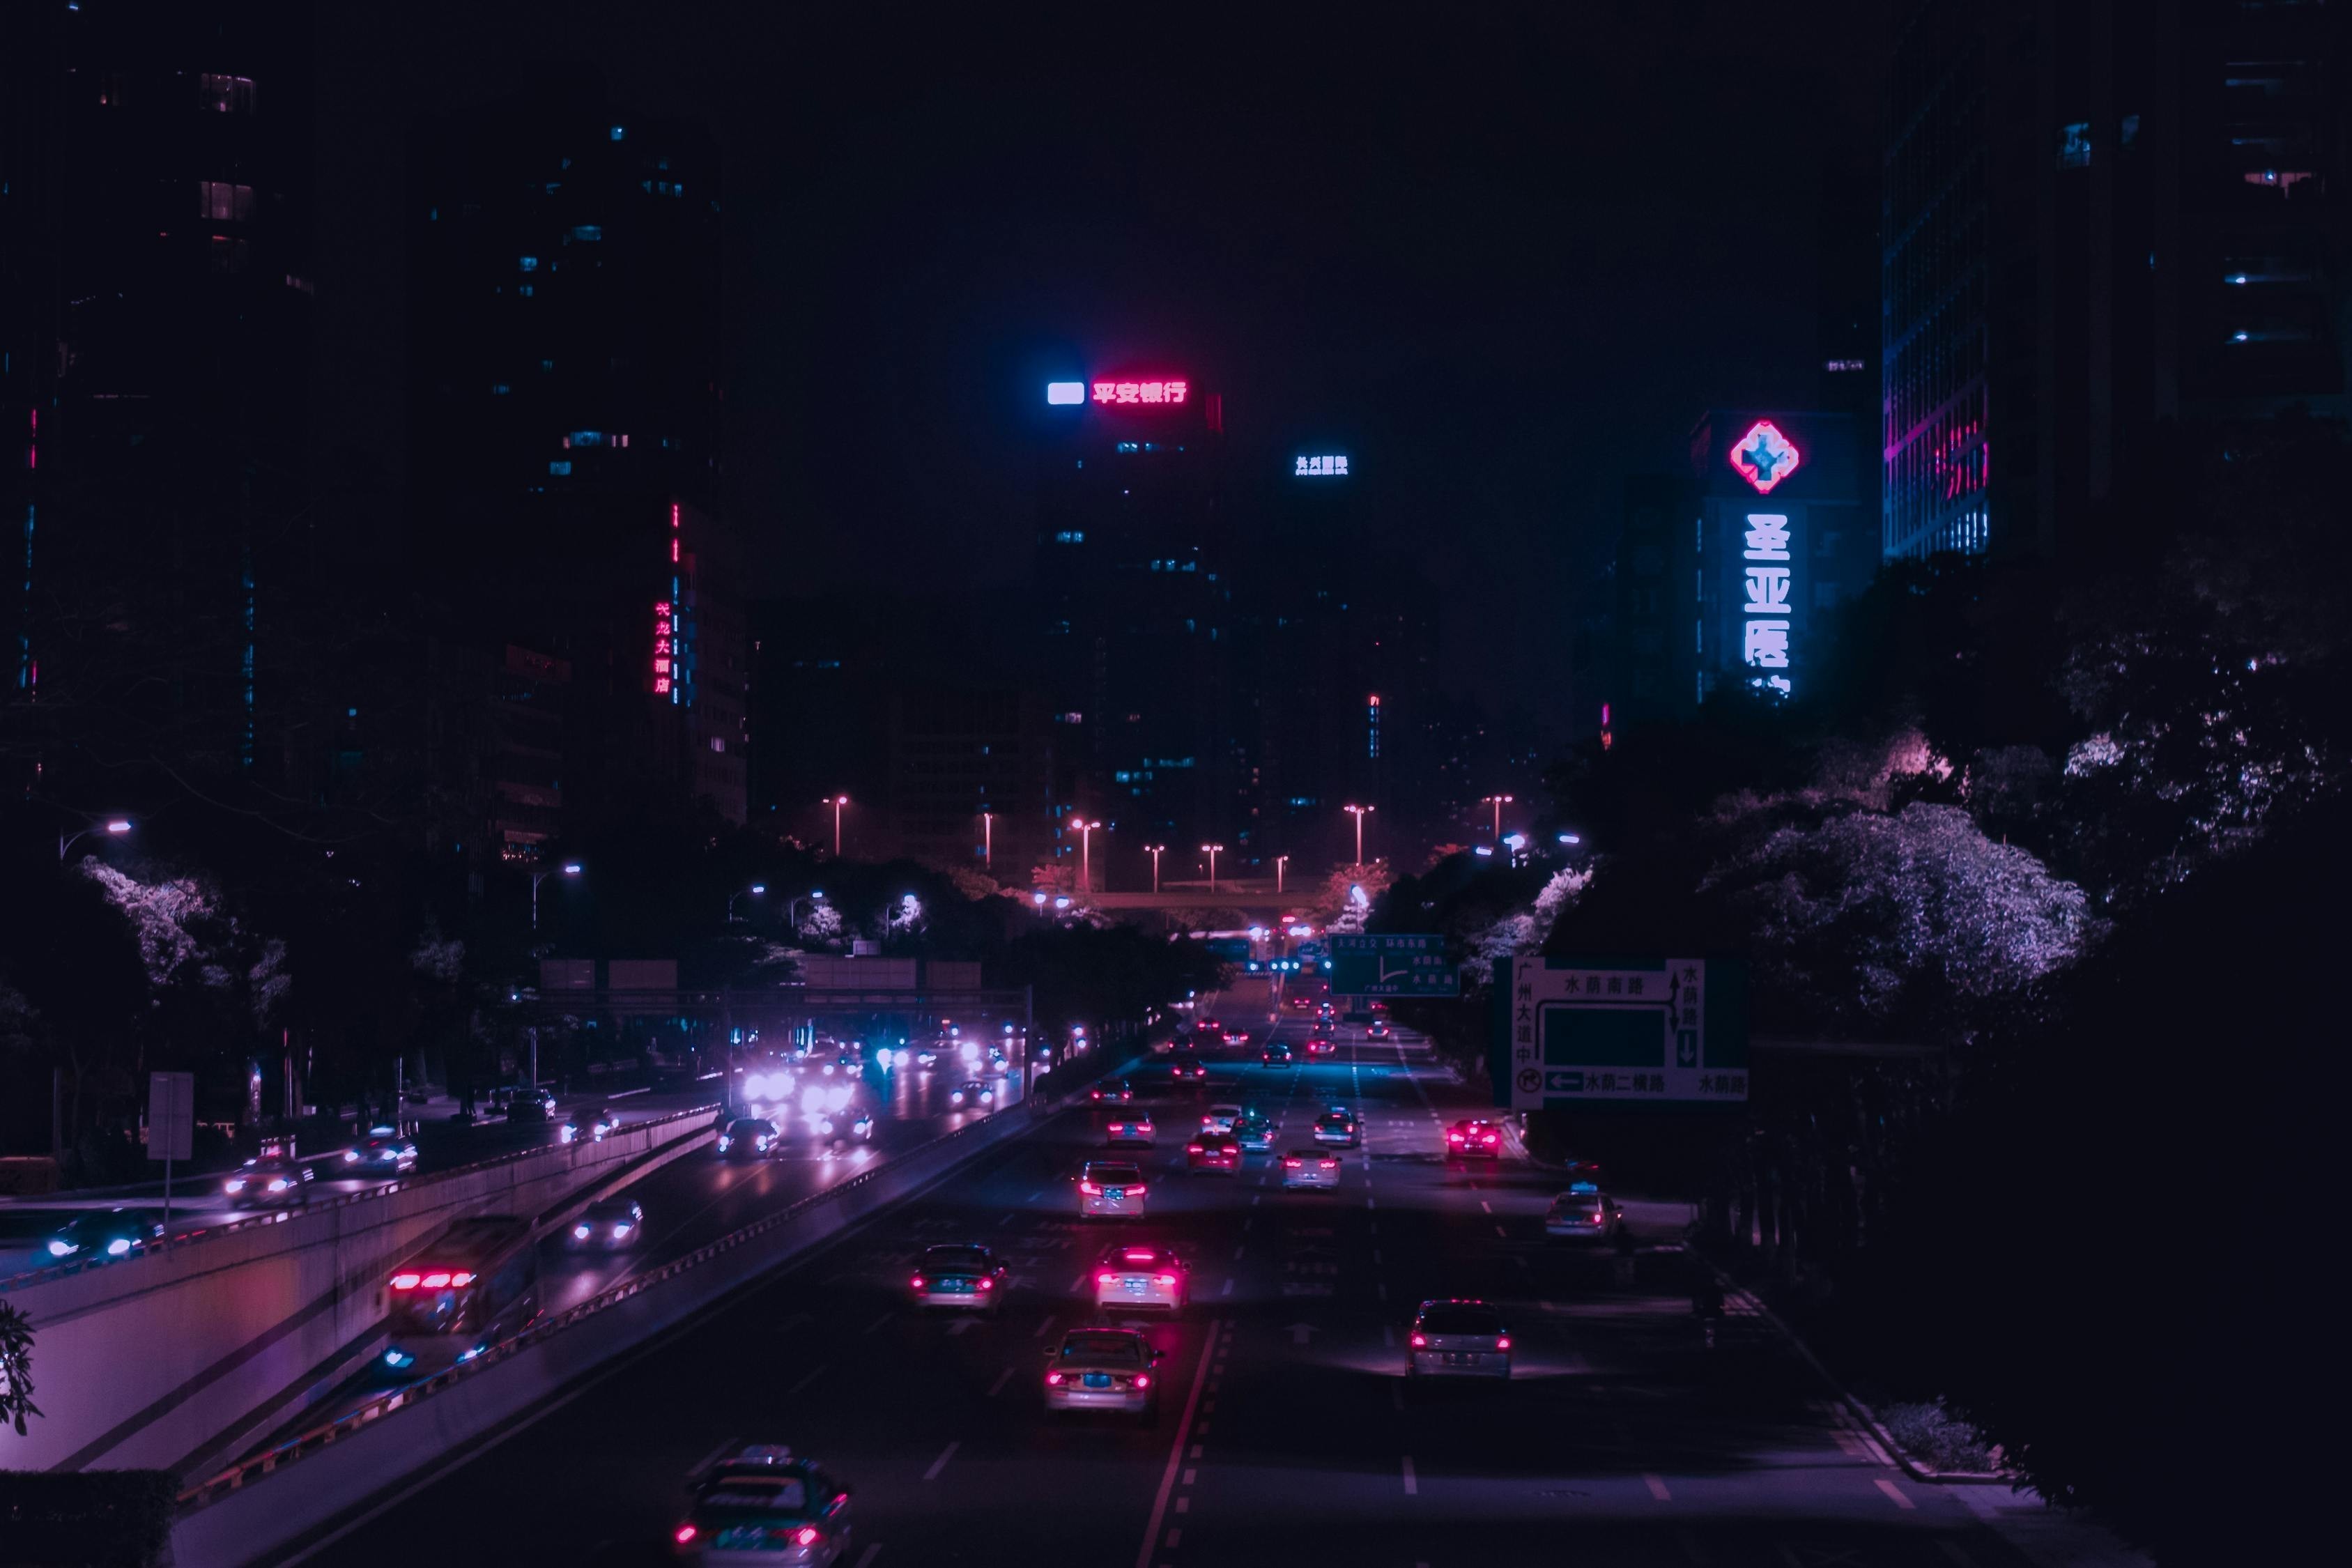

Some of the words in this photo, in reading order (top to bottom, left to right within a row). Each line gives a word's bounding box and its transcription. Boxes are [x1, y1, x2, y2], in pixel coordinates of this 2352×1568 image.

[1093, 383, 1186, 403] 平安银行
[1565, 975, 1643, 994] 水荫南路
[1682, 965, 1698, 1026] 水荫路
[1516, 962, 1532, 1063] 广州大道中
[1585, 1074, 1665, 1092] 水荫二横路
[1698, 1075, 1746, 1094] 水荫路
